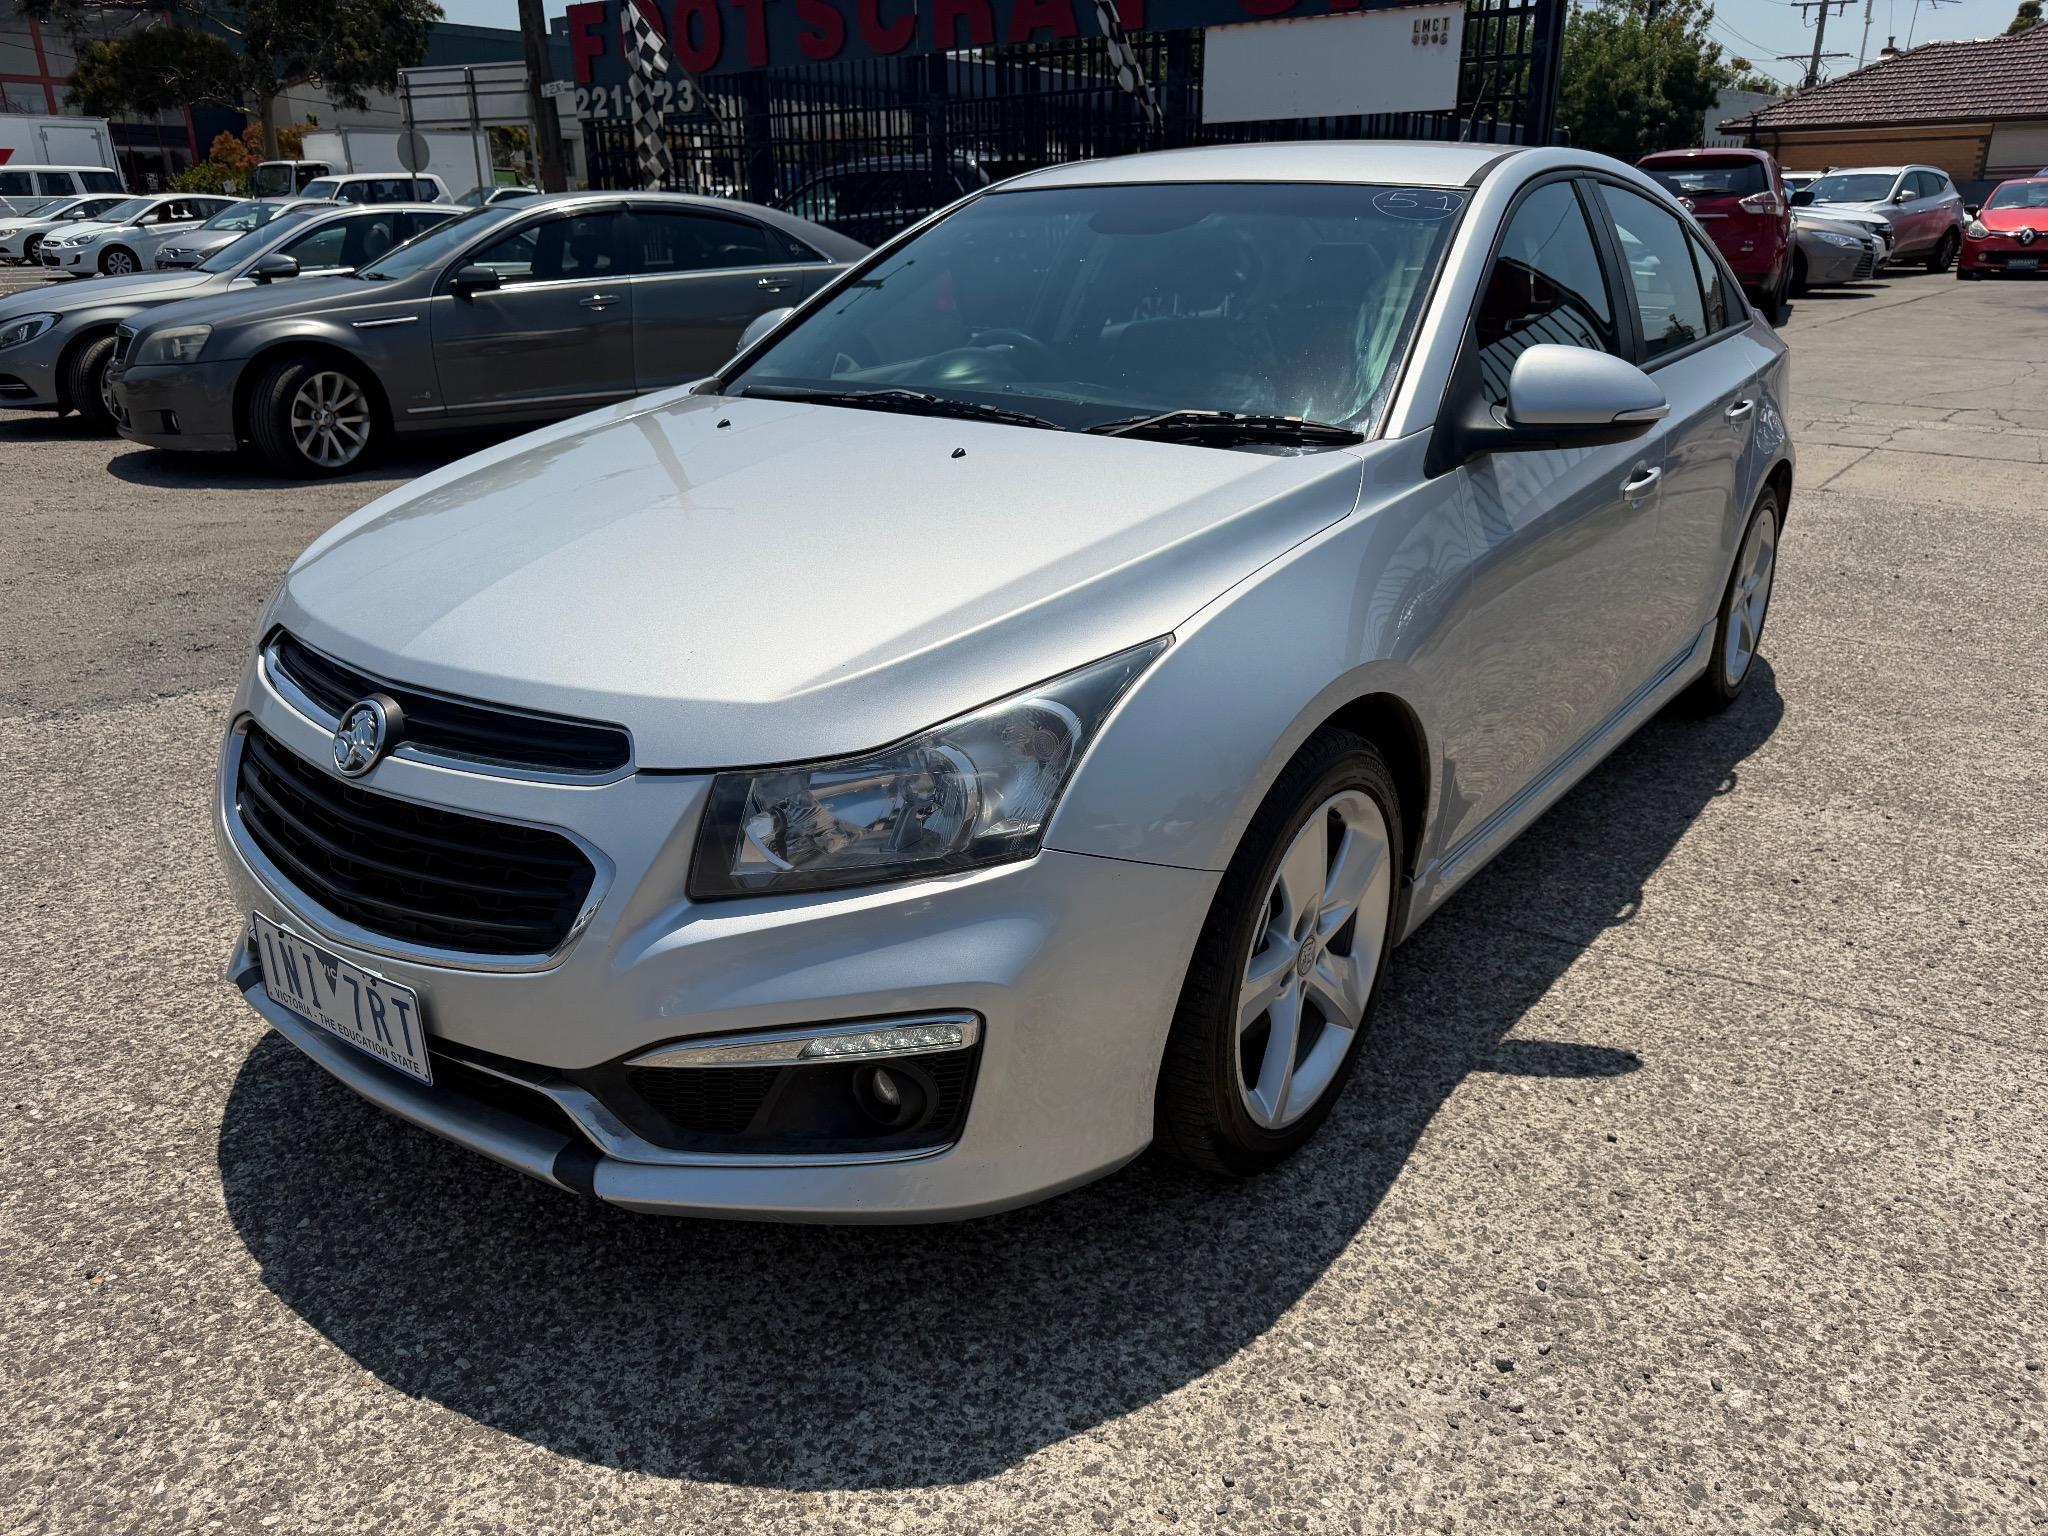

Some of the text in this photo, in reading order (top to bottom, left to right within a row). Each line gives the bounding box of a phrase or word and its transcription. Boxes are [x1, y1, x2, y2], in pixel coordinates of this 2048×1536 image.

[1413, 16, 1450, 34] LMCT
[576, 79, 695, 120] 221-23
[321, 962, 337, 980] VIC
[274, 987, 312, 1018] VICTORIA
[319, 1013, 336, 1030] THE
[338, 1023, 389, 1059] EDUCATION
[391, 1051, 420, 1074] STATE
[343, 974, 414, 1057] 7RT
